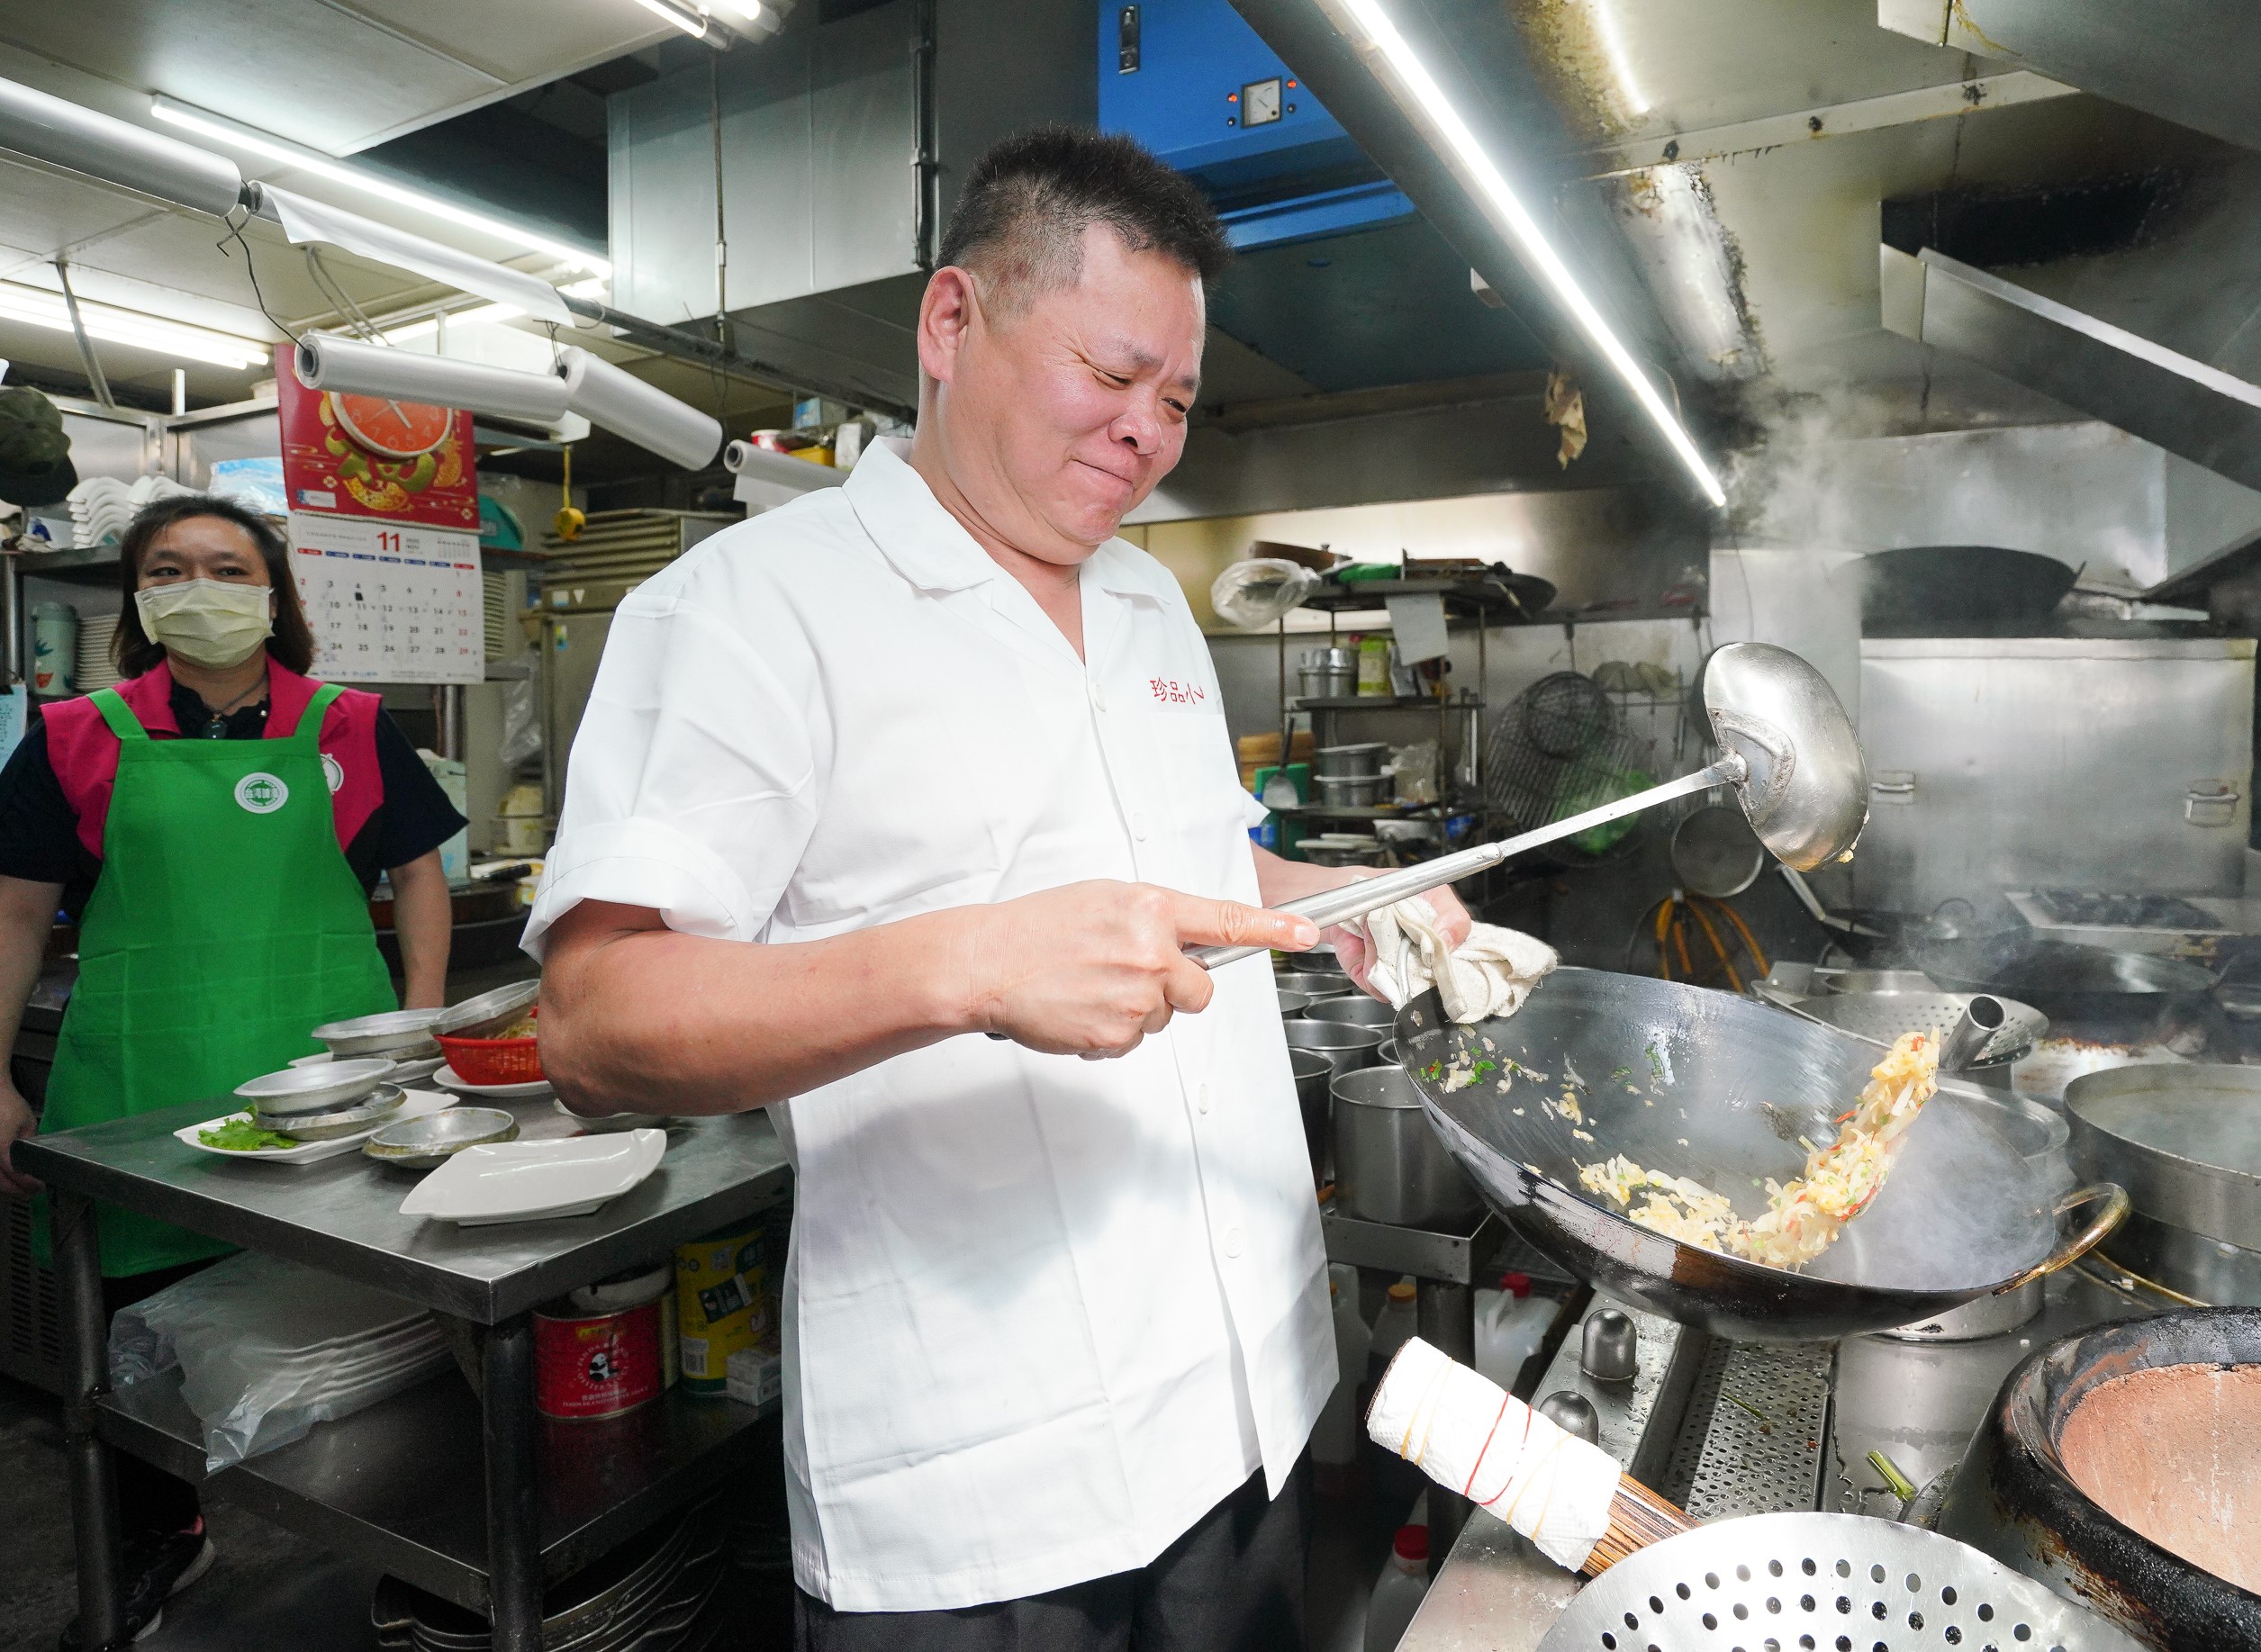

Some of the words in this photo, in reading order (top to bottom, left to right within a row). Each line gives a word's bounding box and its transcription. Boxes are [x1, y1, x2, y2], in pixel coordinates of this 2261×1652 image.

[376, 531, 401, 553] 11
[300, 578, 306, 586] 2
[327, 580, 333, 588] 3
[381, 584, 387, 592] 5
[457, 609, 468, 617] 15
[357, 623, 368, 631] 18
[384, 645, 394, 653] 26
[1150, 677, 1205, 705] 珍品小
